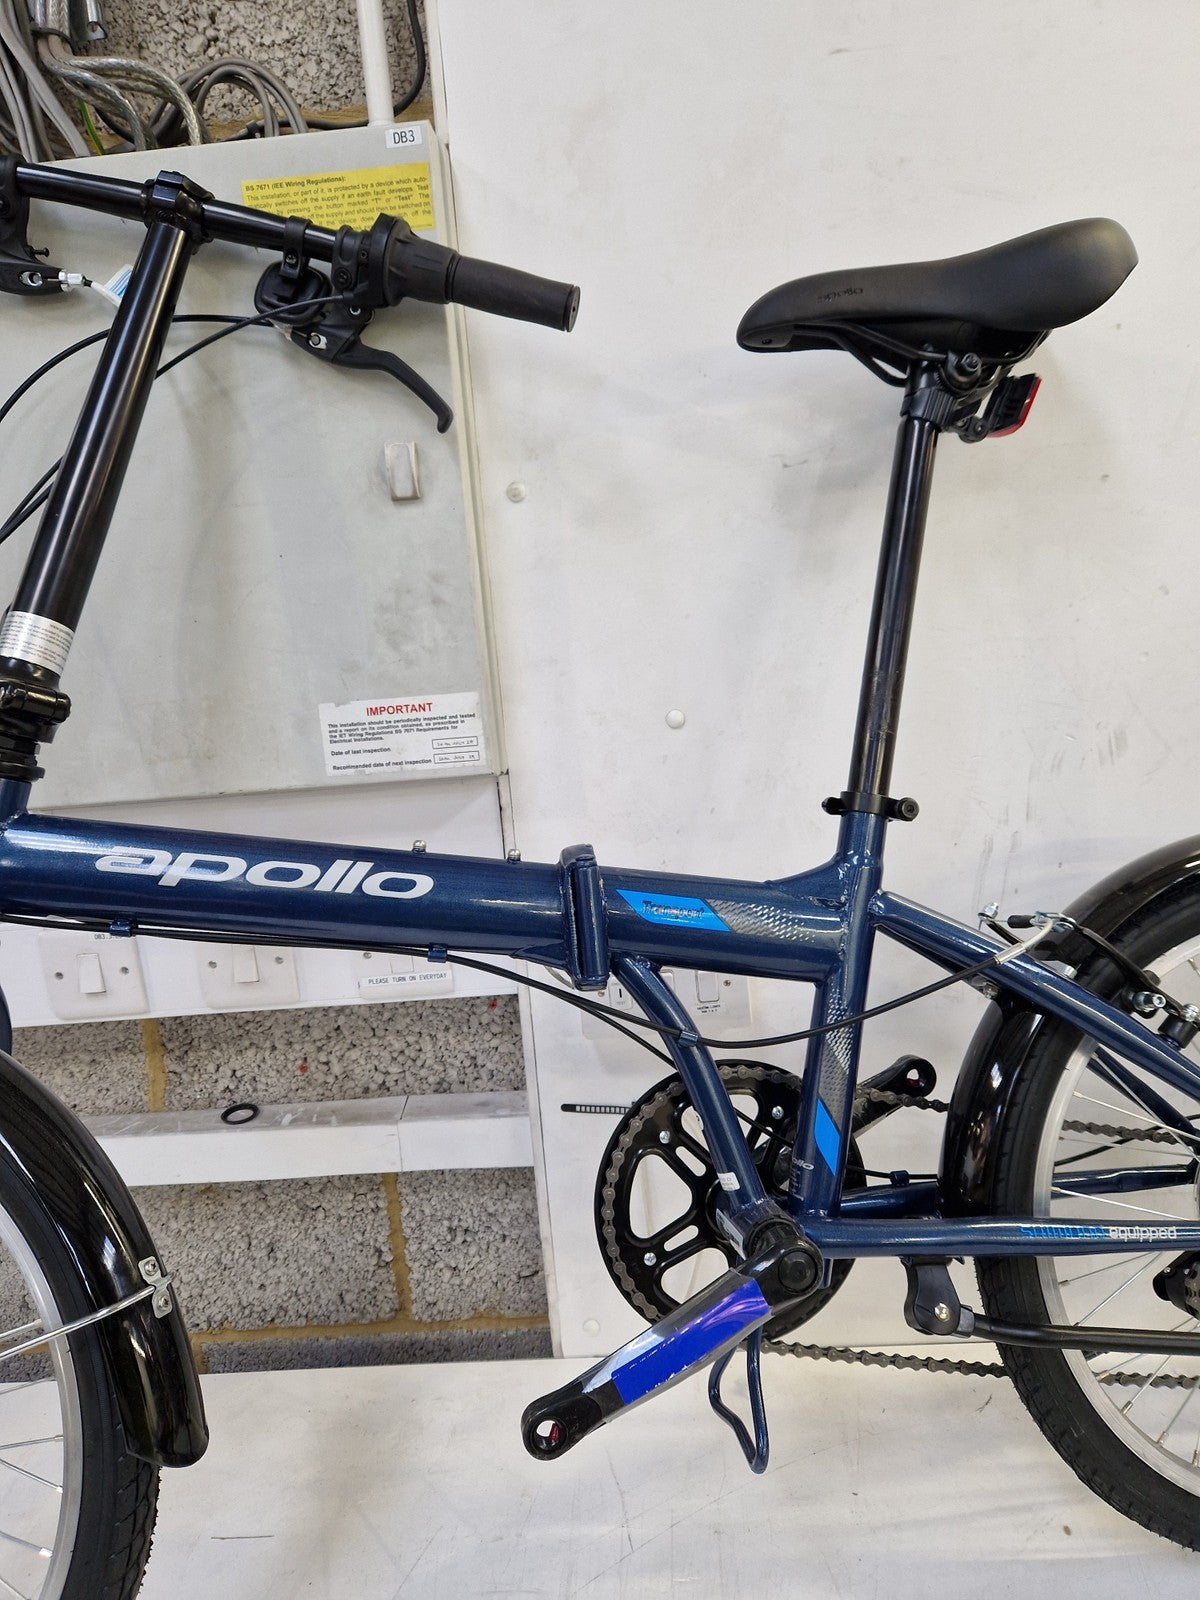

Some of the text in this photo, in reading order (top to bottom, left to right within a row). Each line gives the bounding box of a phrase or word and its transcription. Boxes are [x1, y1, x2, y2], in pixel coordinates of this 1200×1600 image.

[392, 130, 415, 144] DB3
[300, 189, 312, 198] part
[334, 183, 360, 193] protected
[322, 194, 340, 202] supply
[398, 200, 422, 209] switched
[287, 206, 310, 214] pressing
[366, 702, 432, 716] IMPORTANT
[95, 846, 434, 900] apollo
[368, 976, 389, 984] PLEASE
[419, 972, 447, 980] EVERYDAY
[1109, 1226, 1177, 1242] equipped
